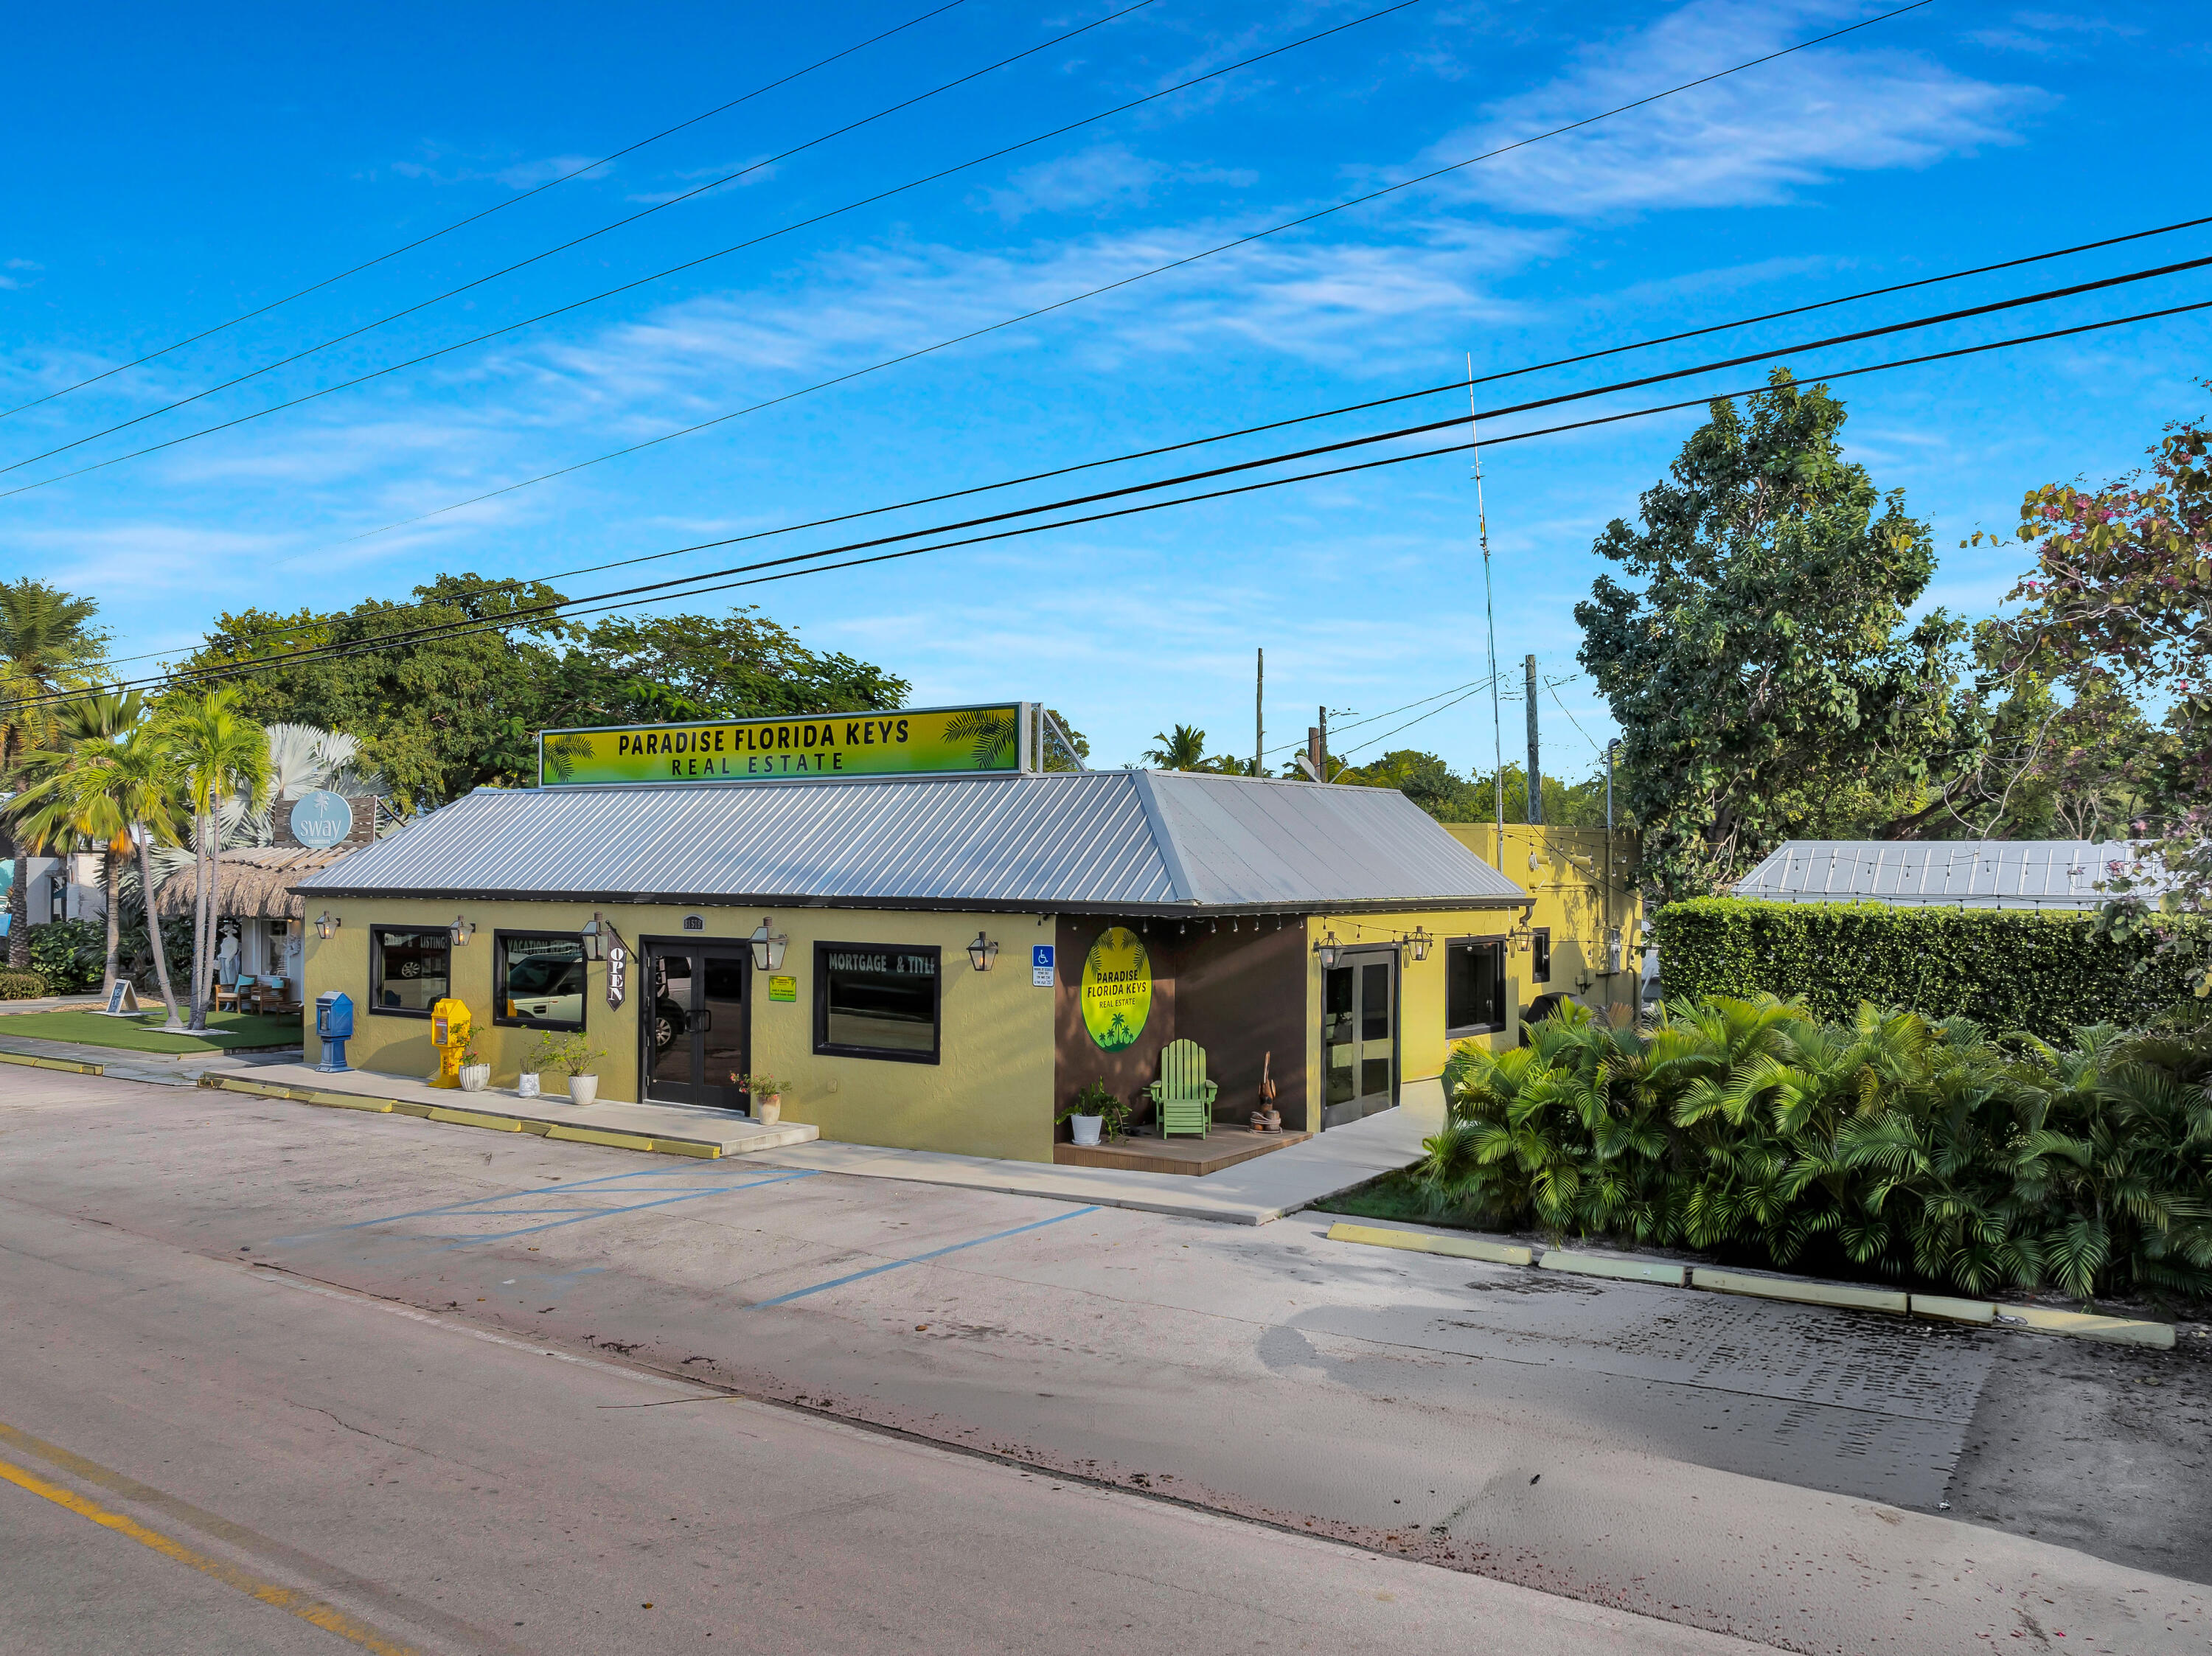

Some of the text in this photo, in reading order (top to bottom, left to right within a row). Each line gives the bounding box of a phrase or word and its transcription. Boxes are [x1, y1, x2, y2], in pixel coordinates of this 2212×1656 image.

[619, 719, 909, 756] PARADISE FLORIDA KEYS
[672, 752, 843, 776] REAL ESTATE
[300, 819, 341, 841] sway
[507, 939, 548, 954] VACATION
[828, 953, 887, 973] MORTGAGE
[896, 955, 905, 973] &
[607, 947, 625, 1001] OPEN
[1096, 970, 1138, 984] PARADISE
[1087, 981, 1147, 998] FLORIDA KEYS
[1099, 998, 1135, 1009] REAL ESTATE
